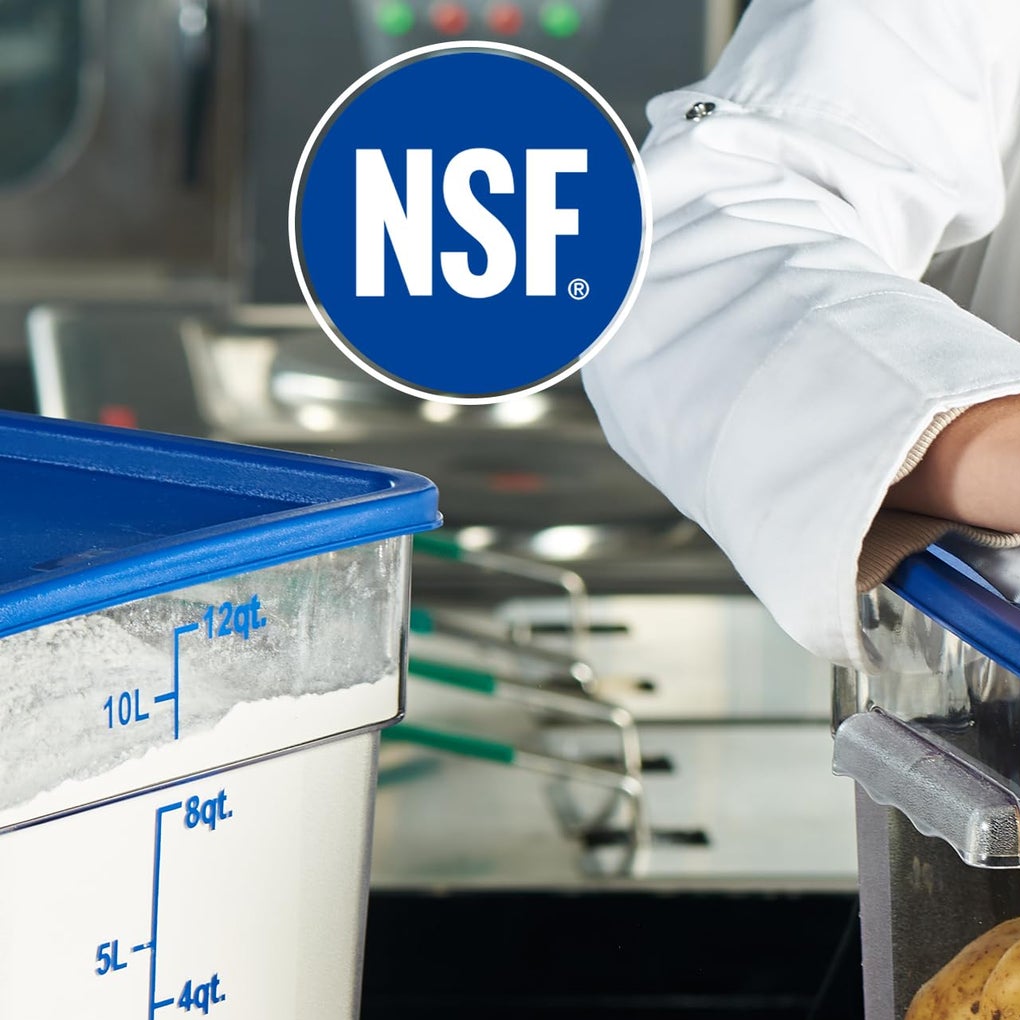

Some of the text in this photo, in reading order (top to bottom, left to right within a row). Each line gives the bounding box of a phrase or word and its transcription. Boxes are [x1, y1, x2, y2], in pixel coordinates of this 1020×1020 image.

[202, 594, 267, 640] 12qt.
[103, 688, 150, 729] 10L
[184, 789, 233, 830] 8qt.
[95, 939, 128, 976] 5L
[177, 973, 226, 1015] 4qt.
